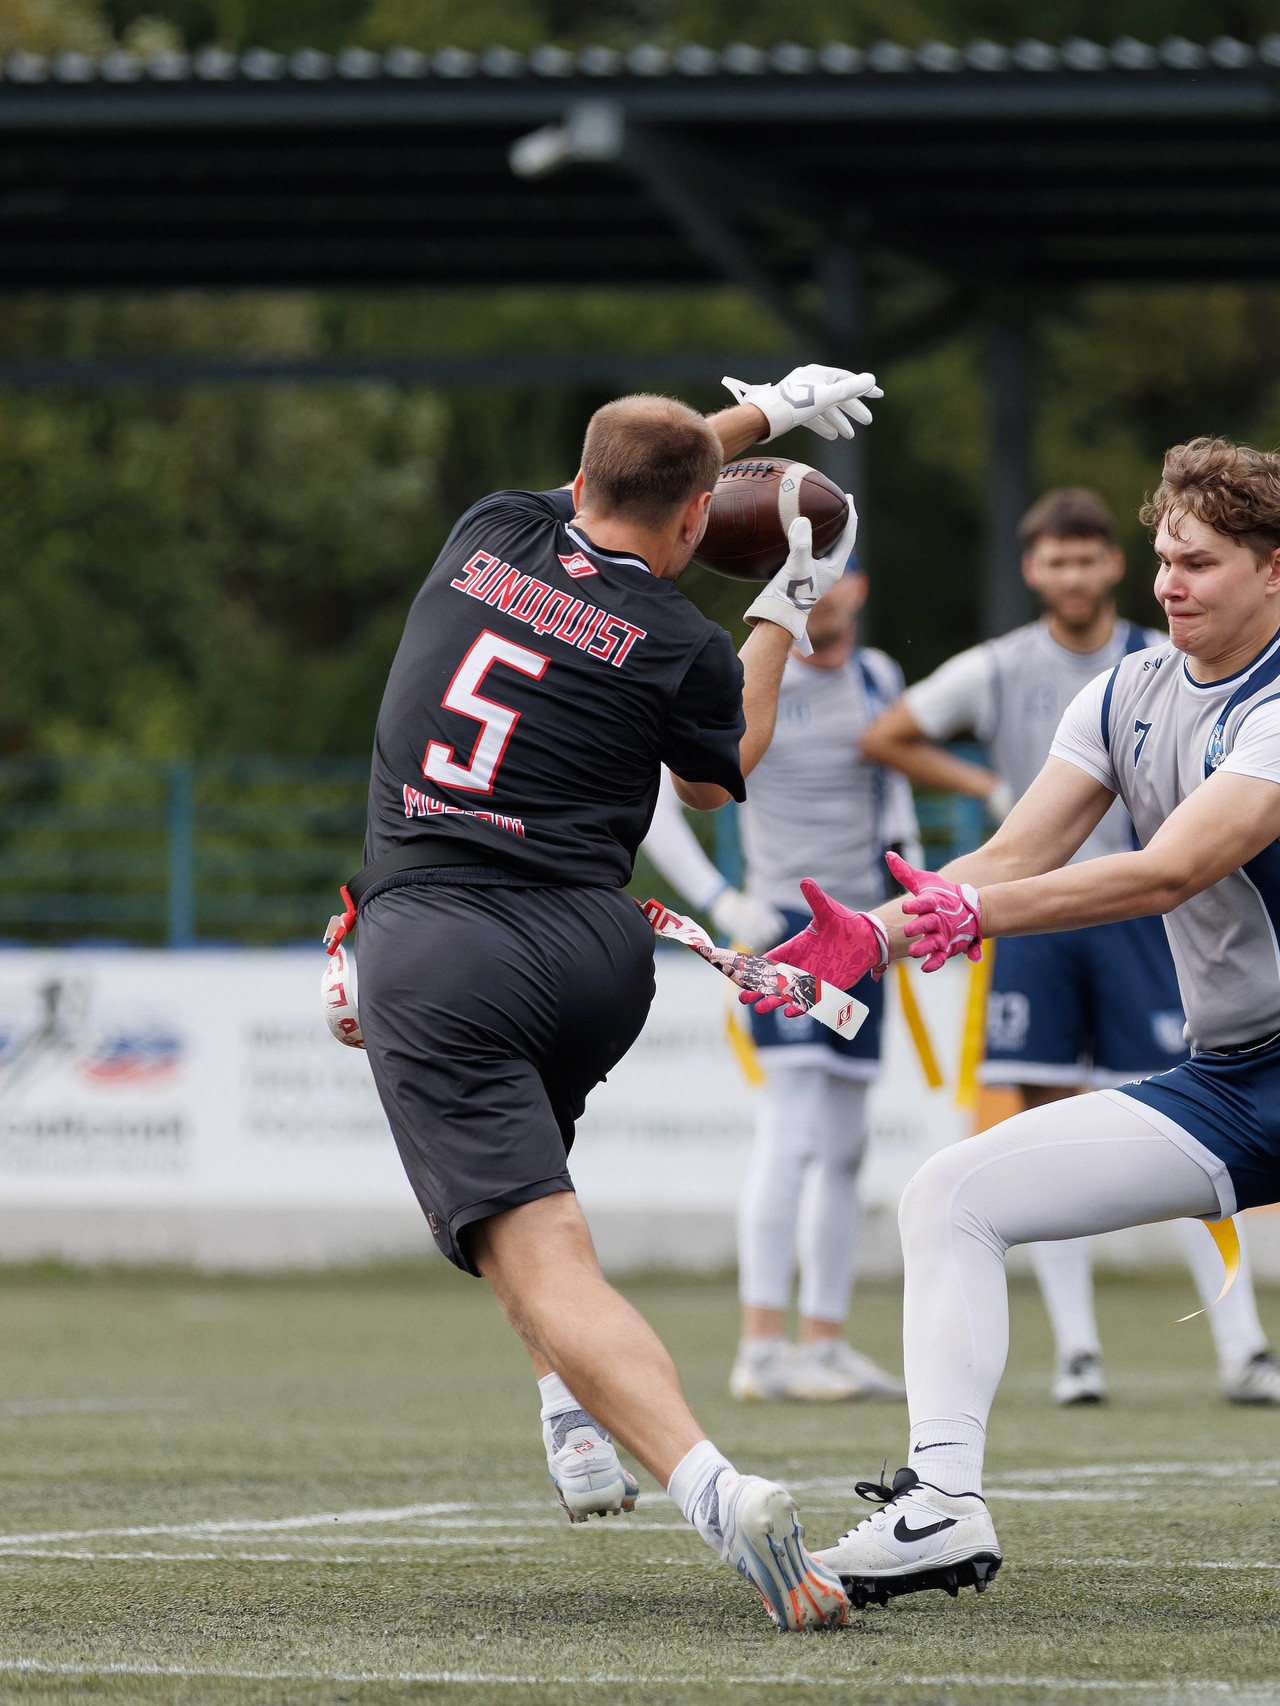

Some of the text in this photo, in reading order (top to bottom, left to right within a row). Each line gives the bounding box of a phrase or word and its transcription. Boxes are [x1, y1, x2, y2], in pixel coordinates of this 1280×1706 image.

[450, 549, 647, 668] SUNDQUIST
[421, 628, 551, 795] 5
[1134, 718, 1153, 769] 7
